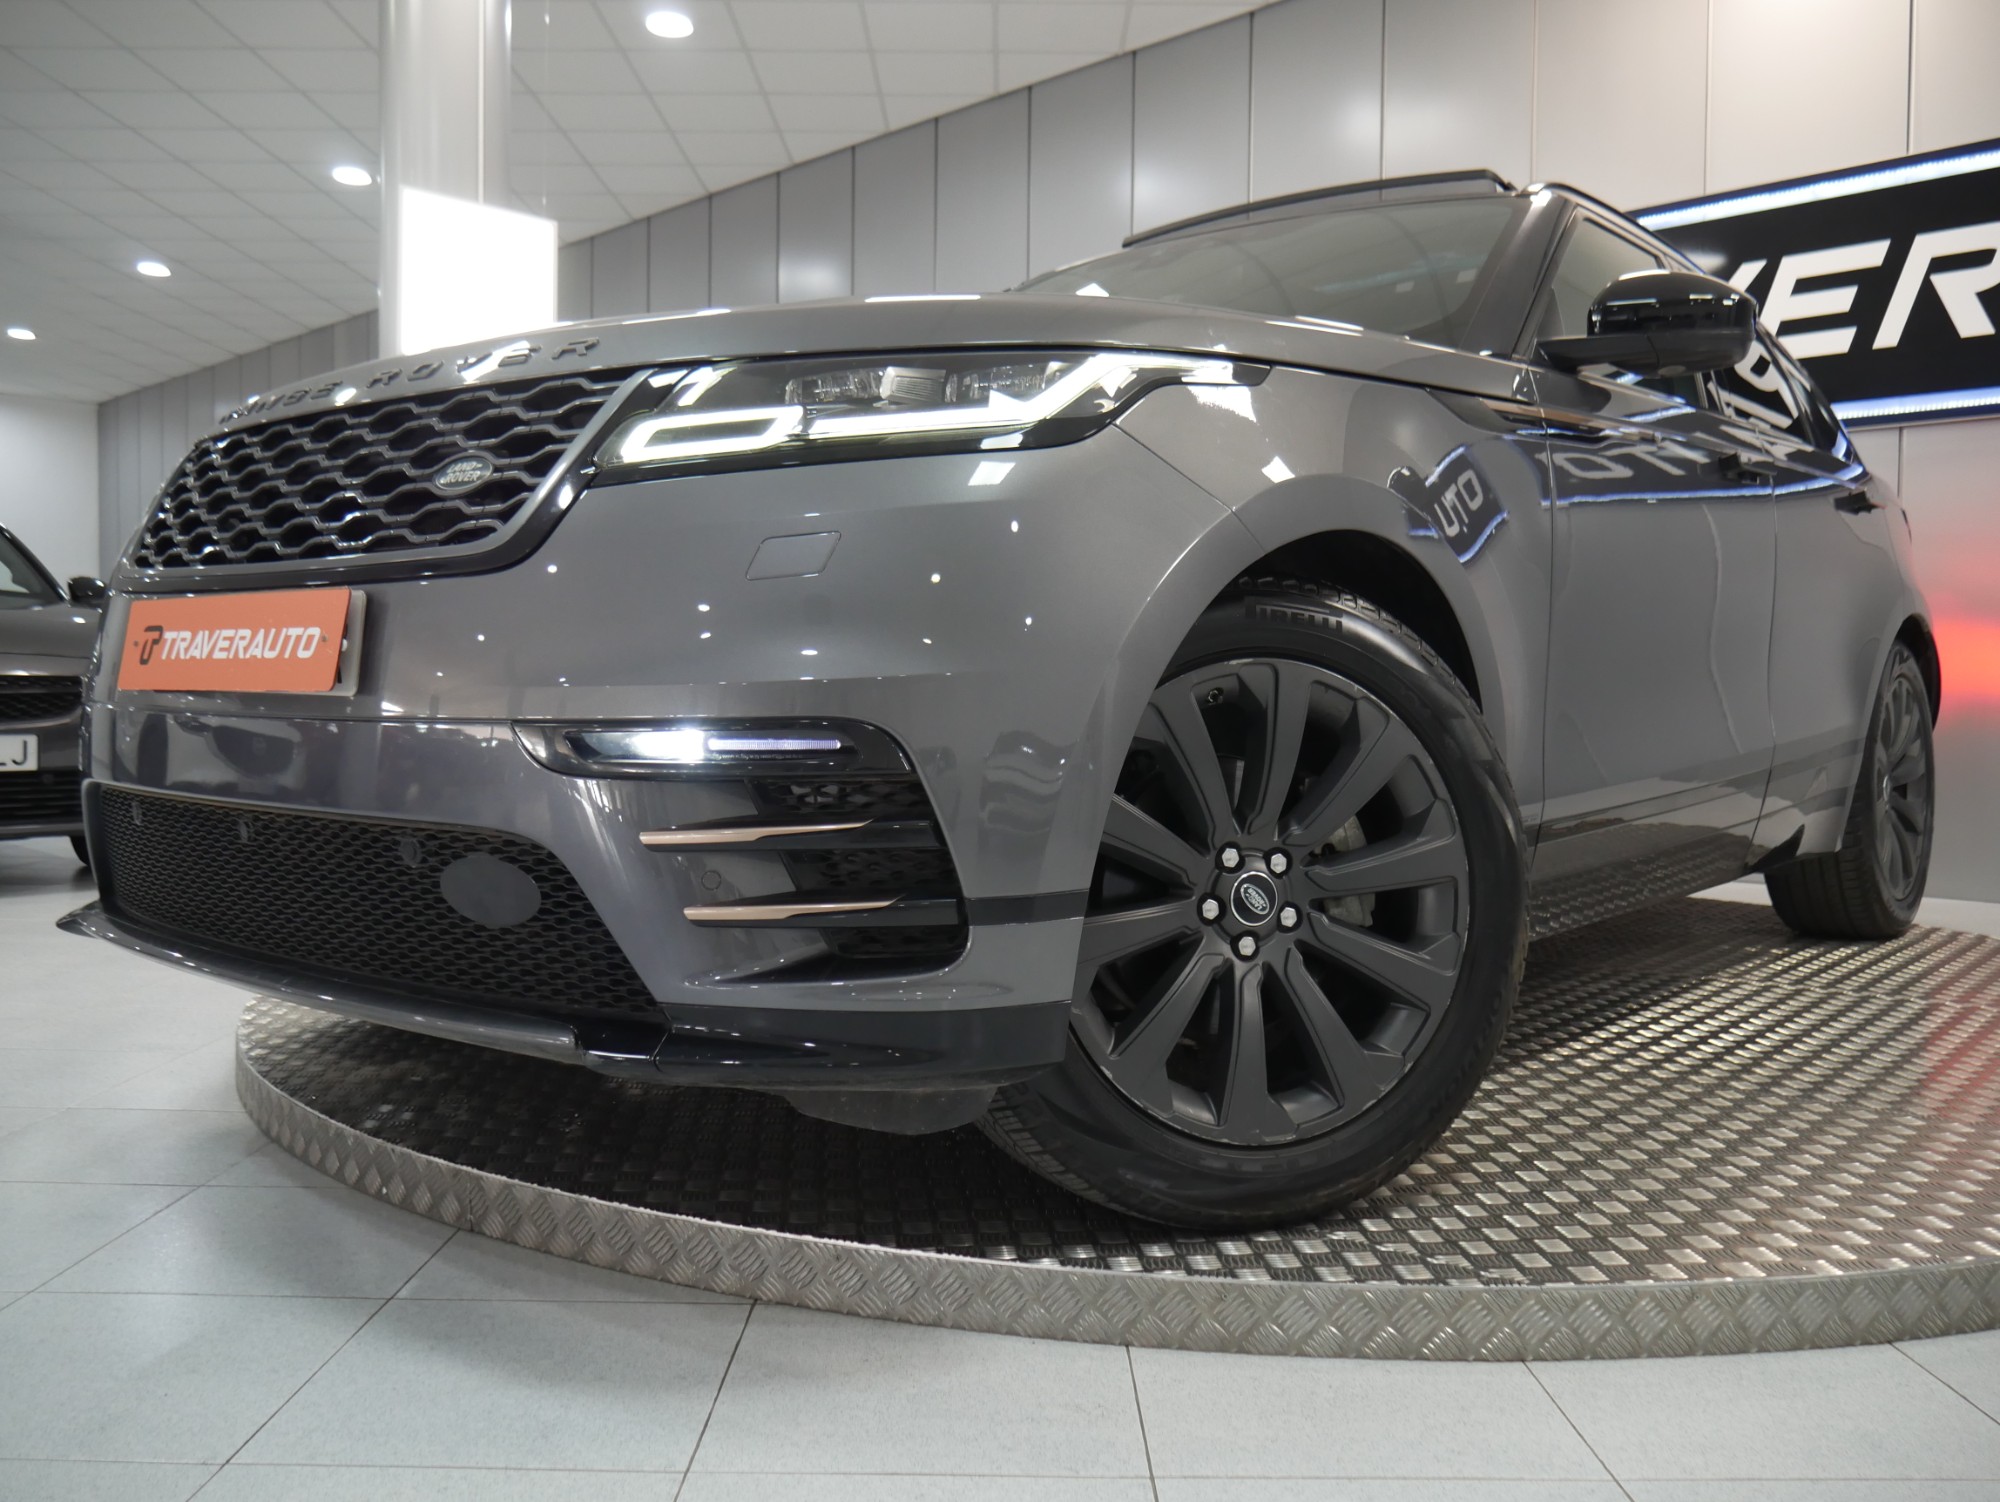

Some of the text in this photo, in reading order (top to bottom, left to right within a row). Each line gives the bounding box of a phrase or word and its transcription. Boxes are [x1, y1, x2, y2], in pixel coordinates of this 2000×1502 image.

[1728, 221, 2000, 361] ER
[446, 461, 478, 473] LAND
[447, 470, 481, 483] ROVER
[161, 626, 321, 661] TRAVERAUTO
